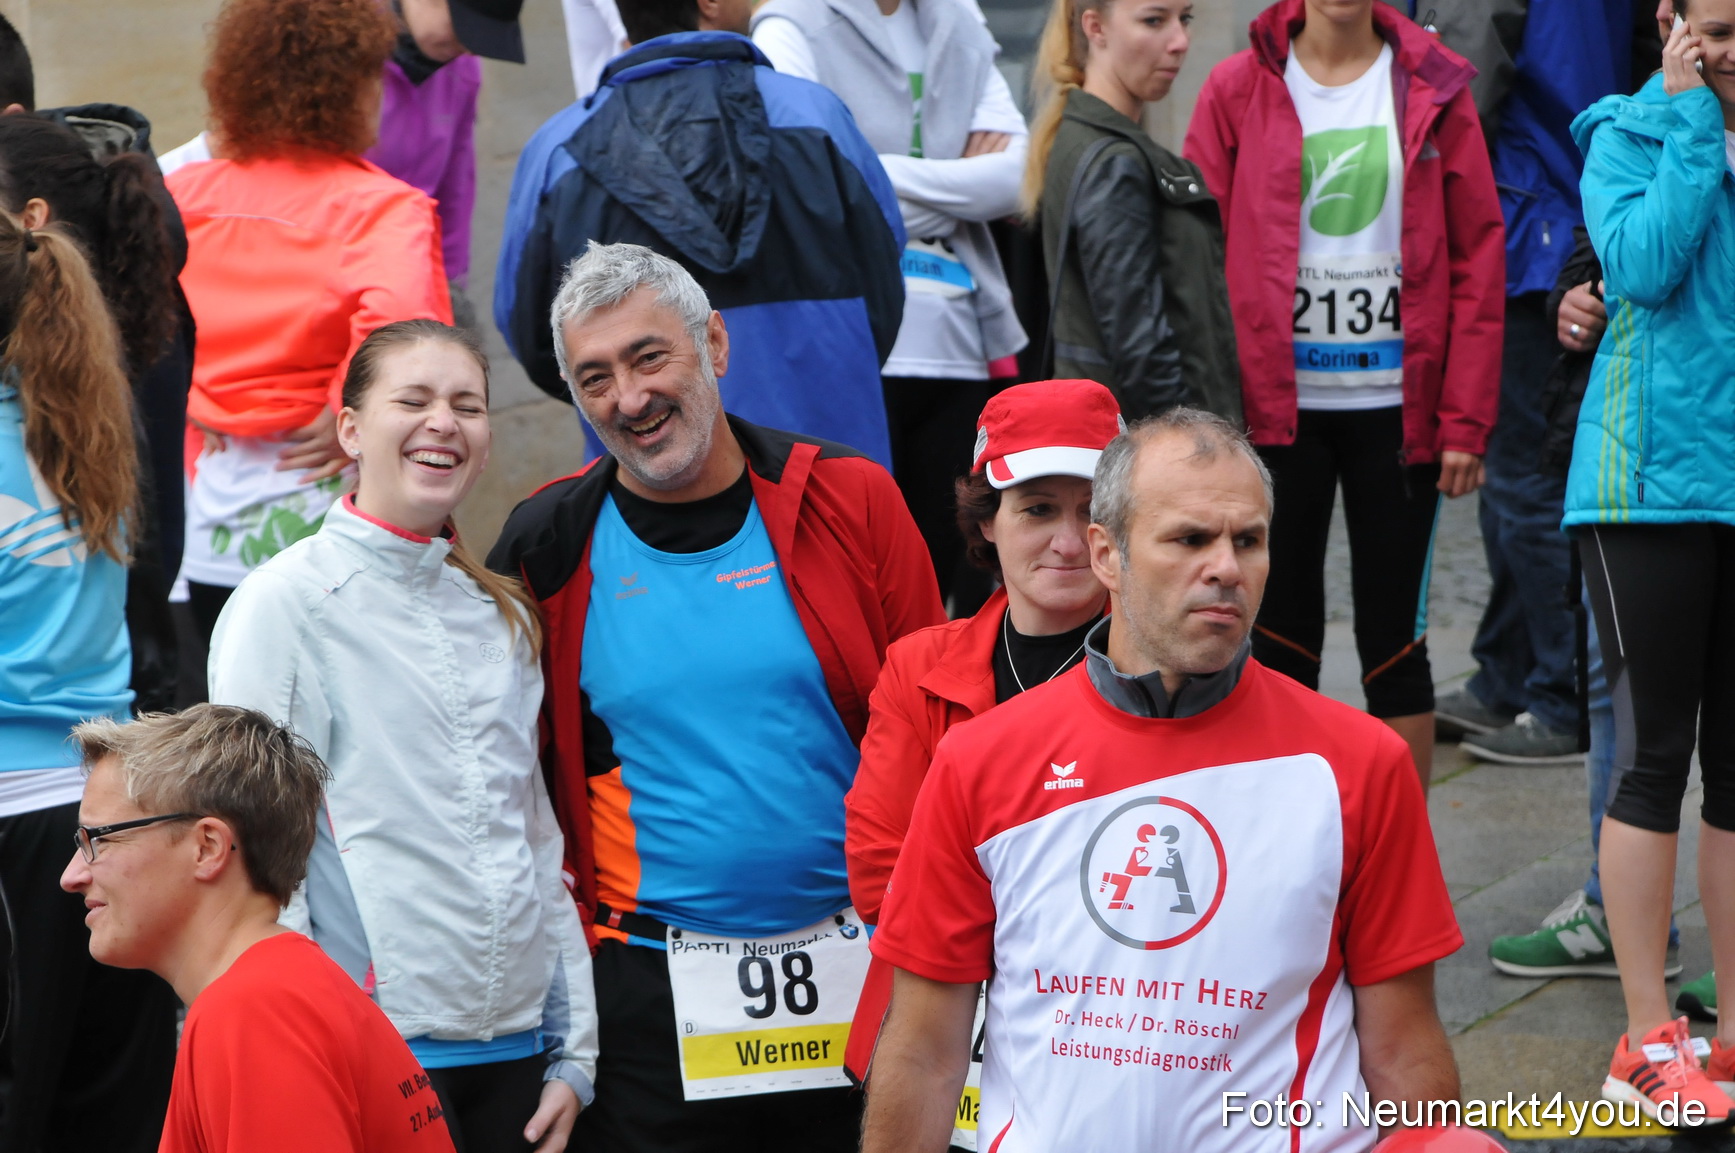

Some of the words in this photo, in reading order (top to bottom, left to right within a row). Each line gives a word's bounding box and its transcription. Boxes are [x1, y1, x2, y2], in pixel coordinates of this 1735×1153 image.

[1324, 266, 1389, 280] Neumarkt
[1293, 285, 1401, 335] 2134
[1307, 348, 1379, 369] Corina
[716, 561, 777, 583] Gipfelstürme
[735, 576, 771, 590] Werner
[1044, 777, 1084, 791] erima
[737, 950, 819, 1020] 98
[1197, 978, 1268, 1011] HERZ
[1055, 1009, 1075, 1026] Dr.
[1081, 1011, 1124, 1029] Heck
[1142, 1016, 1168, 1034] Dr.
[1174, 1019, 1239, 1040] Röschl
[736, 1039, 831, 1067] Werner
[1051, 1037, 1233, 1072] Leistungsdiagnostik
[409, 1112, 427, 1133] 27.
